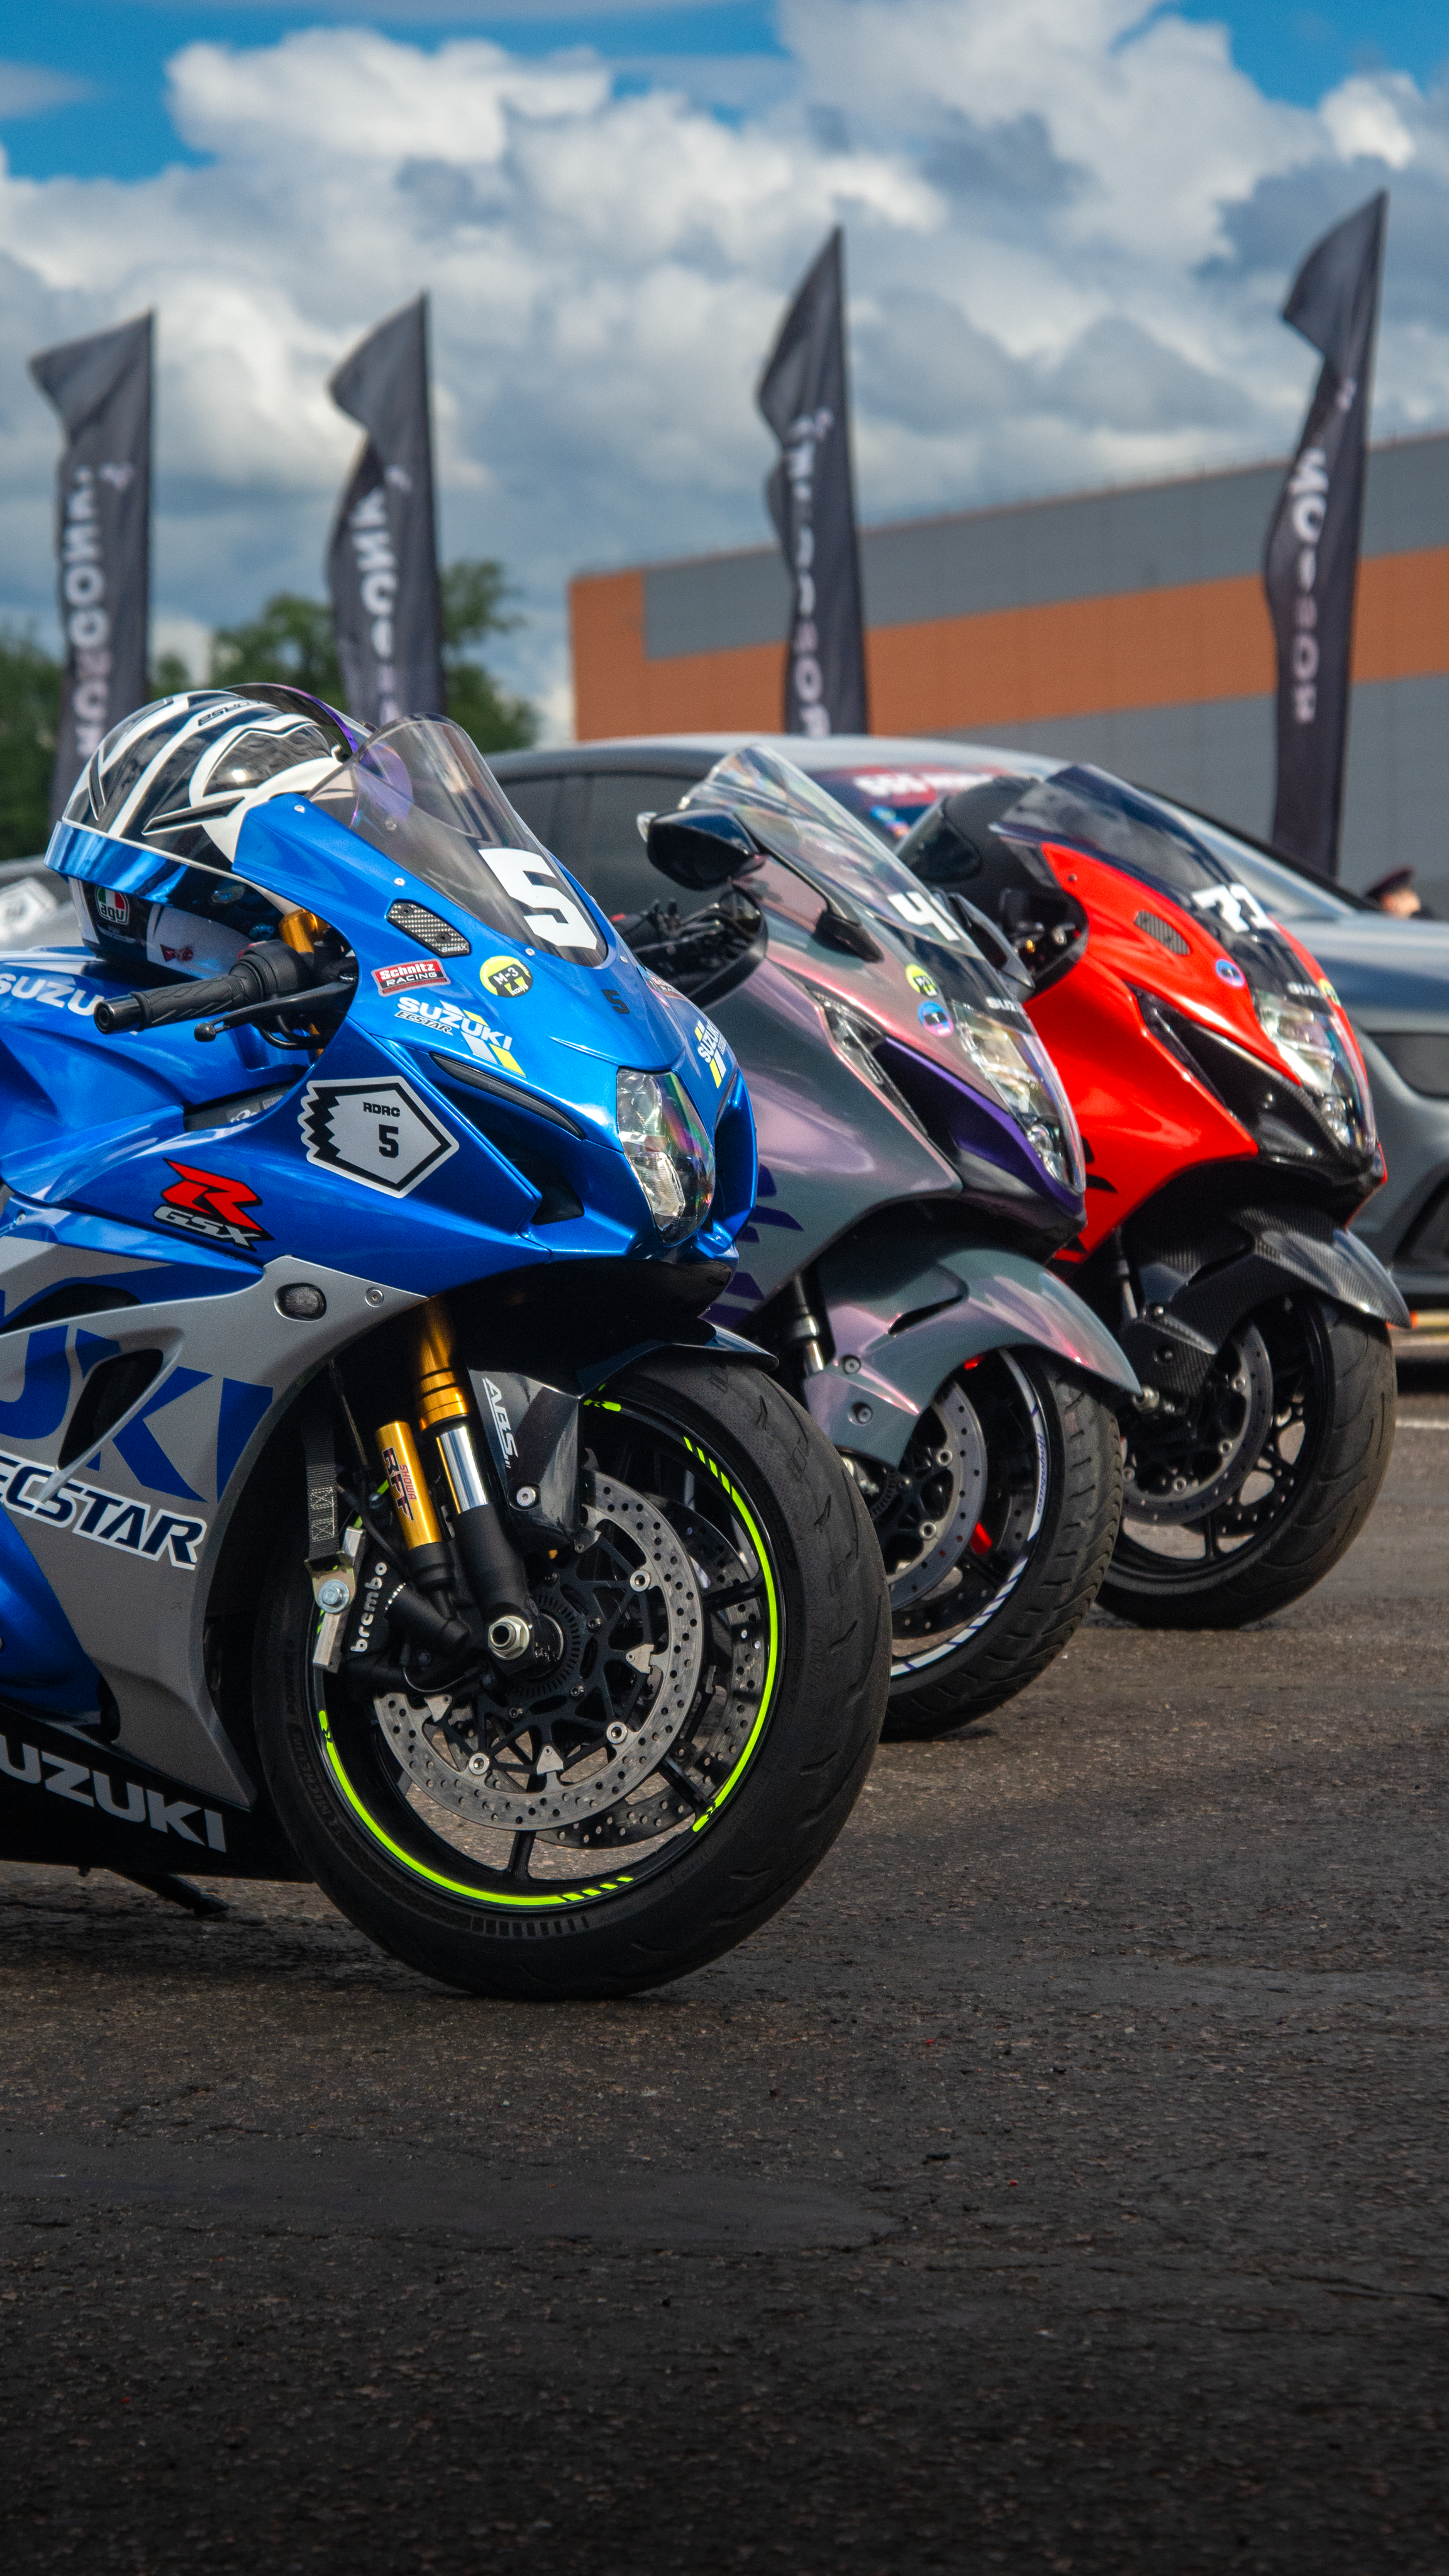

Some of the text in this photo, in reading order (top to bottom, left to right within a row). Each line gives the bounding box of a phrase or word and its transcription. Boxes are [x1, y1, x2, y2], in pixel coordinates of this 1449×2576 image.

[101, 903, 125, 921] agv
[478, 847, 597, 950] 5
[887, 891, 972, 942] 4
[379, 963, 435, 980] Schnitz
[386, 971, 438, 987] RACING
[492, 967, 519, 985] M-3
[0, 973, 106, 1016] SUZU
[601, 989, 630, 1014] 5
[395, 1010, 453, 1036] ECSTAR
[397, 996, 513, 1051] SUZUKI
[363, 1101, 400, 1118] RDRC
[378, 1123, 399, 1159] 5
[153, 1204, 262, 1247] GSX
[484, 1377, 519, 1458] ABS
[399, 1464, 418, 1500] SHOWA
[0, 1734, 226, 1853] UZUKI
